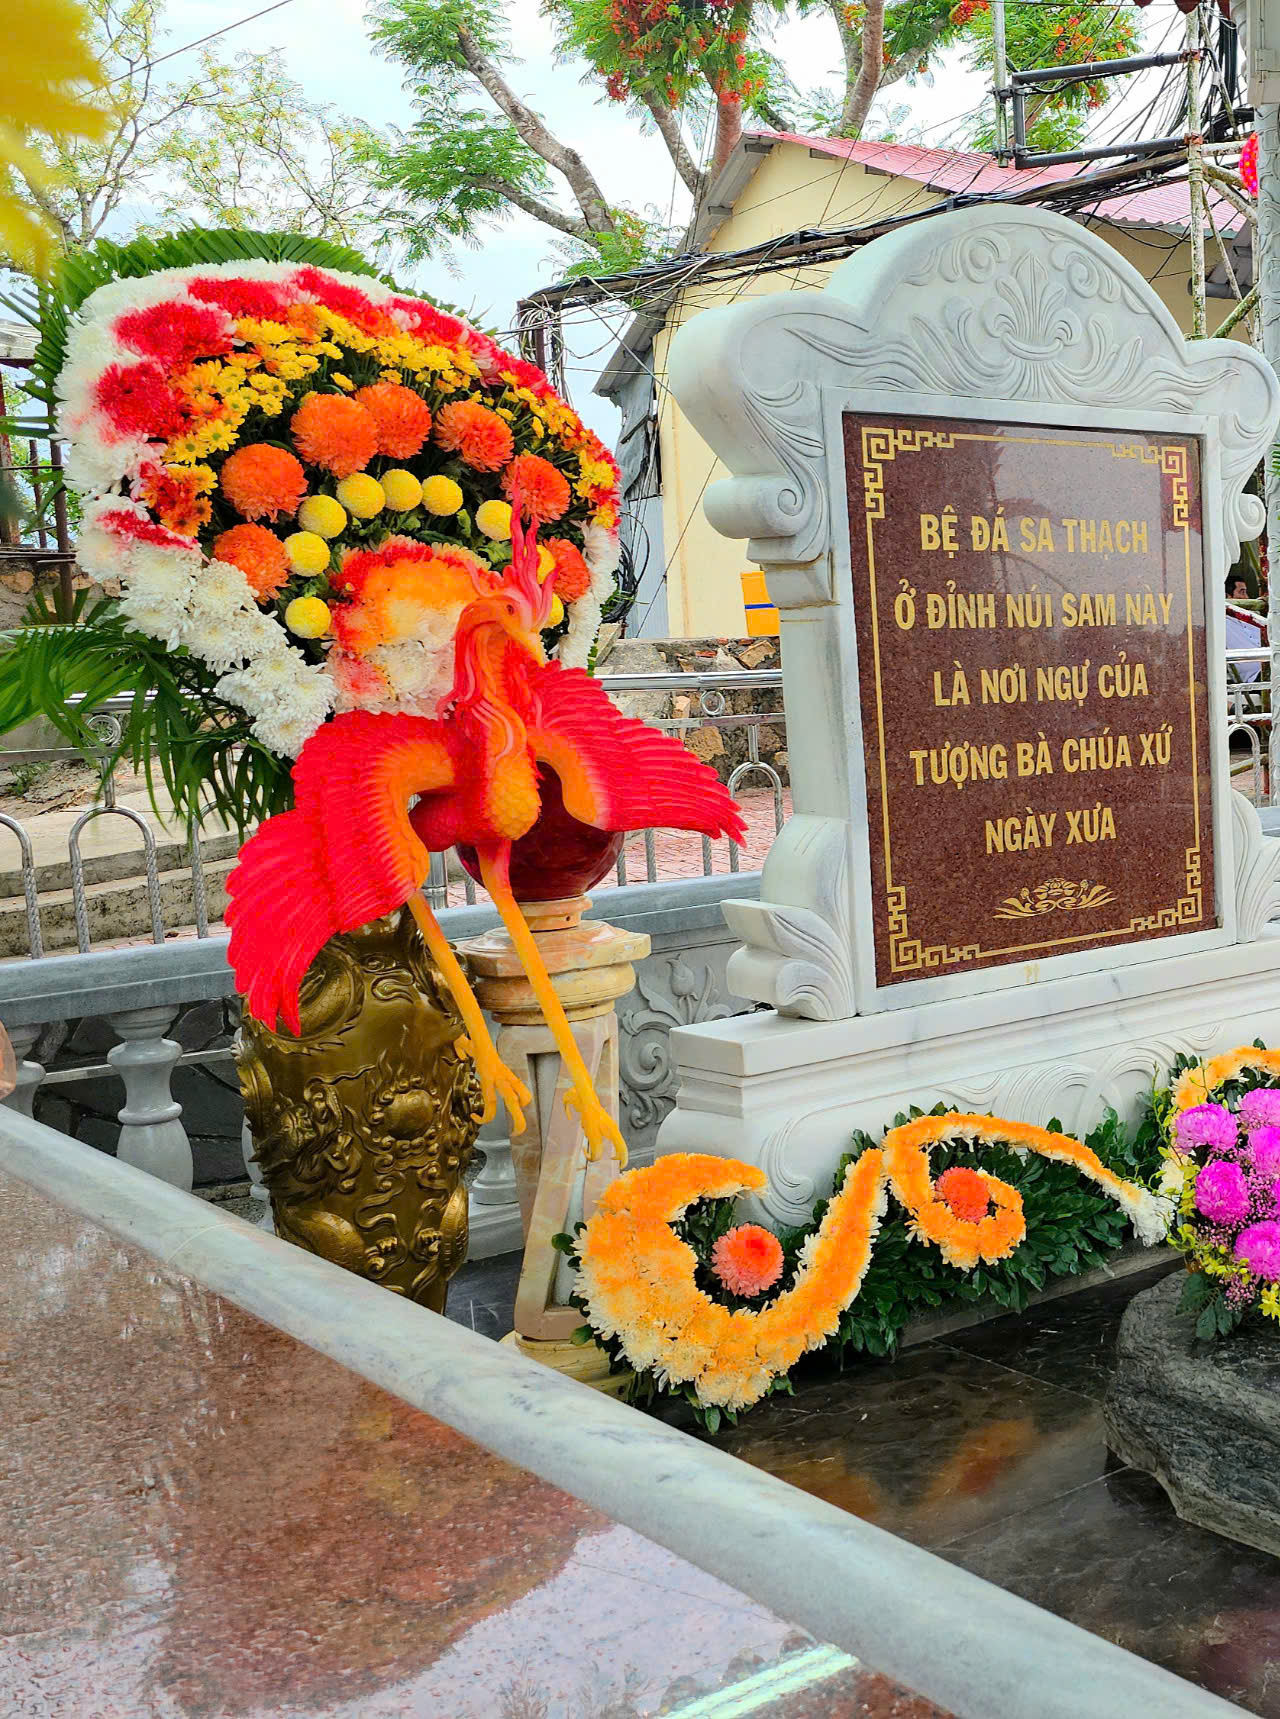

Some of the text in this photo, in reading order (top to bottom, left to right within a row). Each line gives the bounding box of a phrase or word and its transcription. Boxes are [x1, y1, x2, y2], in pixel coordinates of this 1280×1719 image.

[920, 505, 1147, 560] BỆ ĐÁ SA THẠCH
[895, 579, 1171, 630] Ở ĐỈNH NÚI SAM NÀY
[934, 652, 1148, 707] LÀ NƠI NGỰ CỦA
[910, 723, 1172, 789] TƯỢNG BÀ CHÚA XỨ
[986, 802, 1116, 854] NGÀY XƯA
